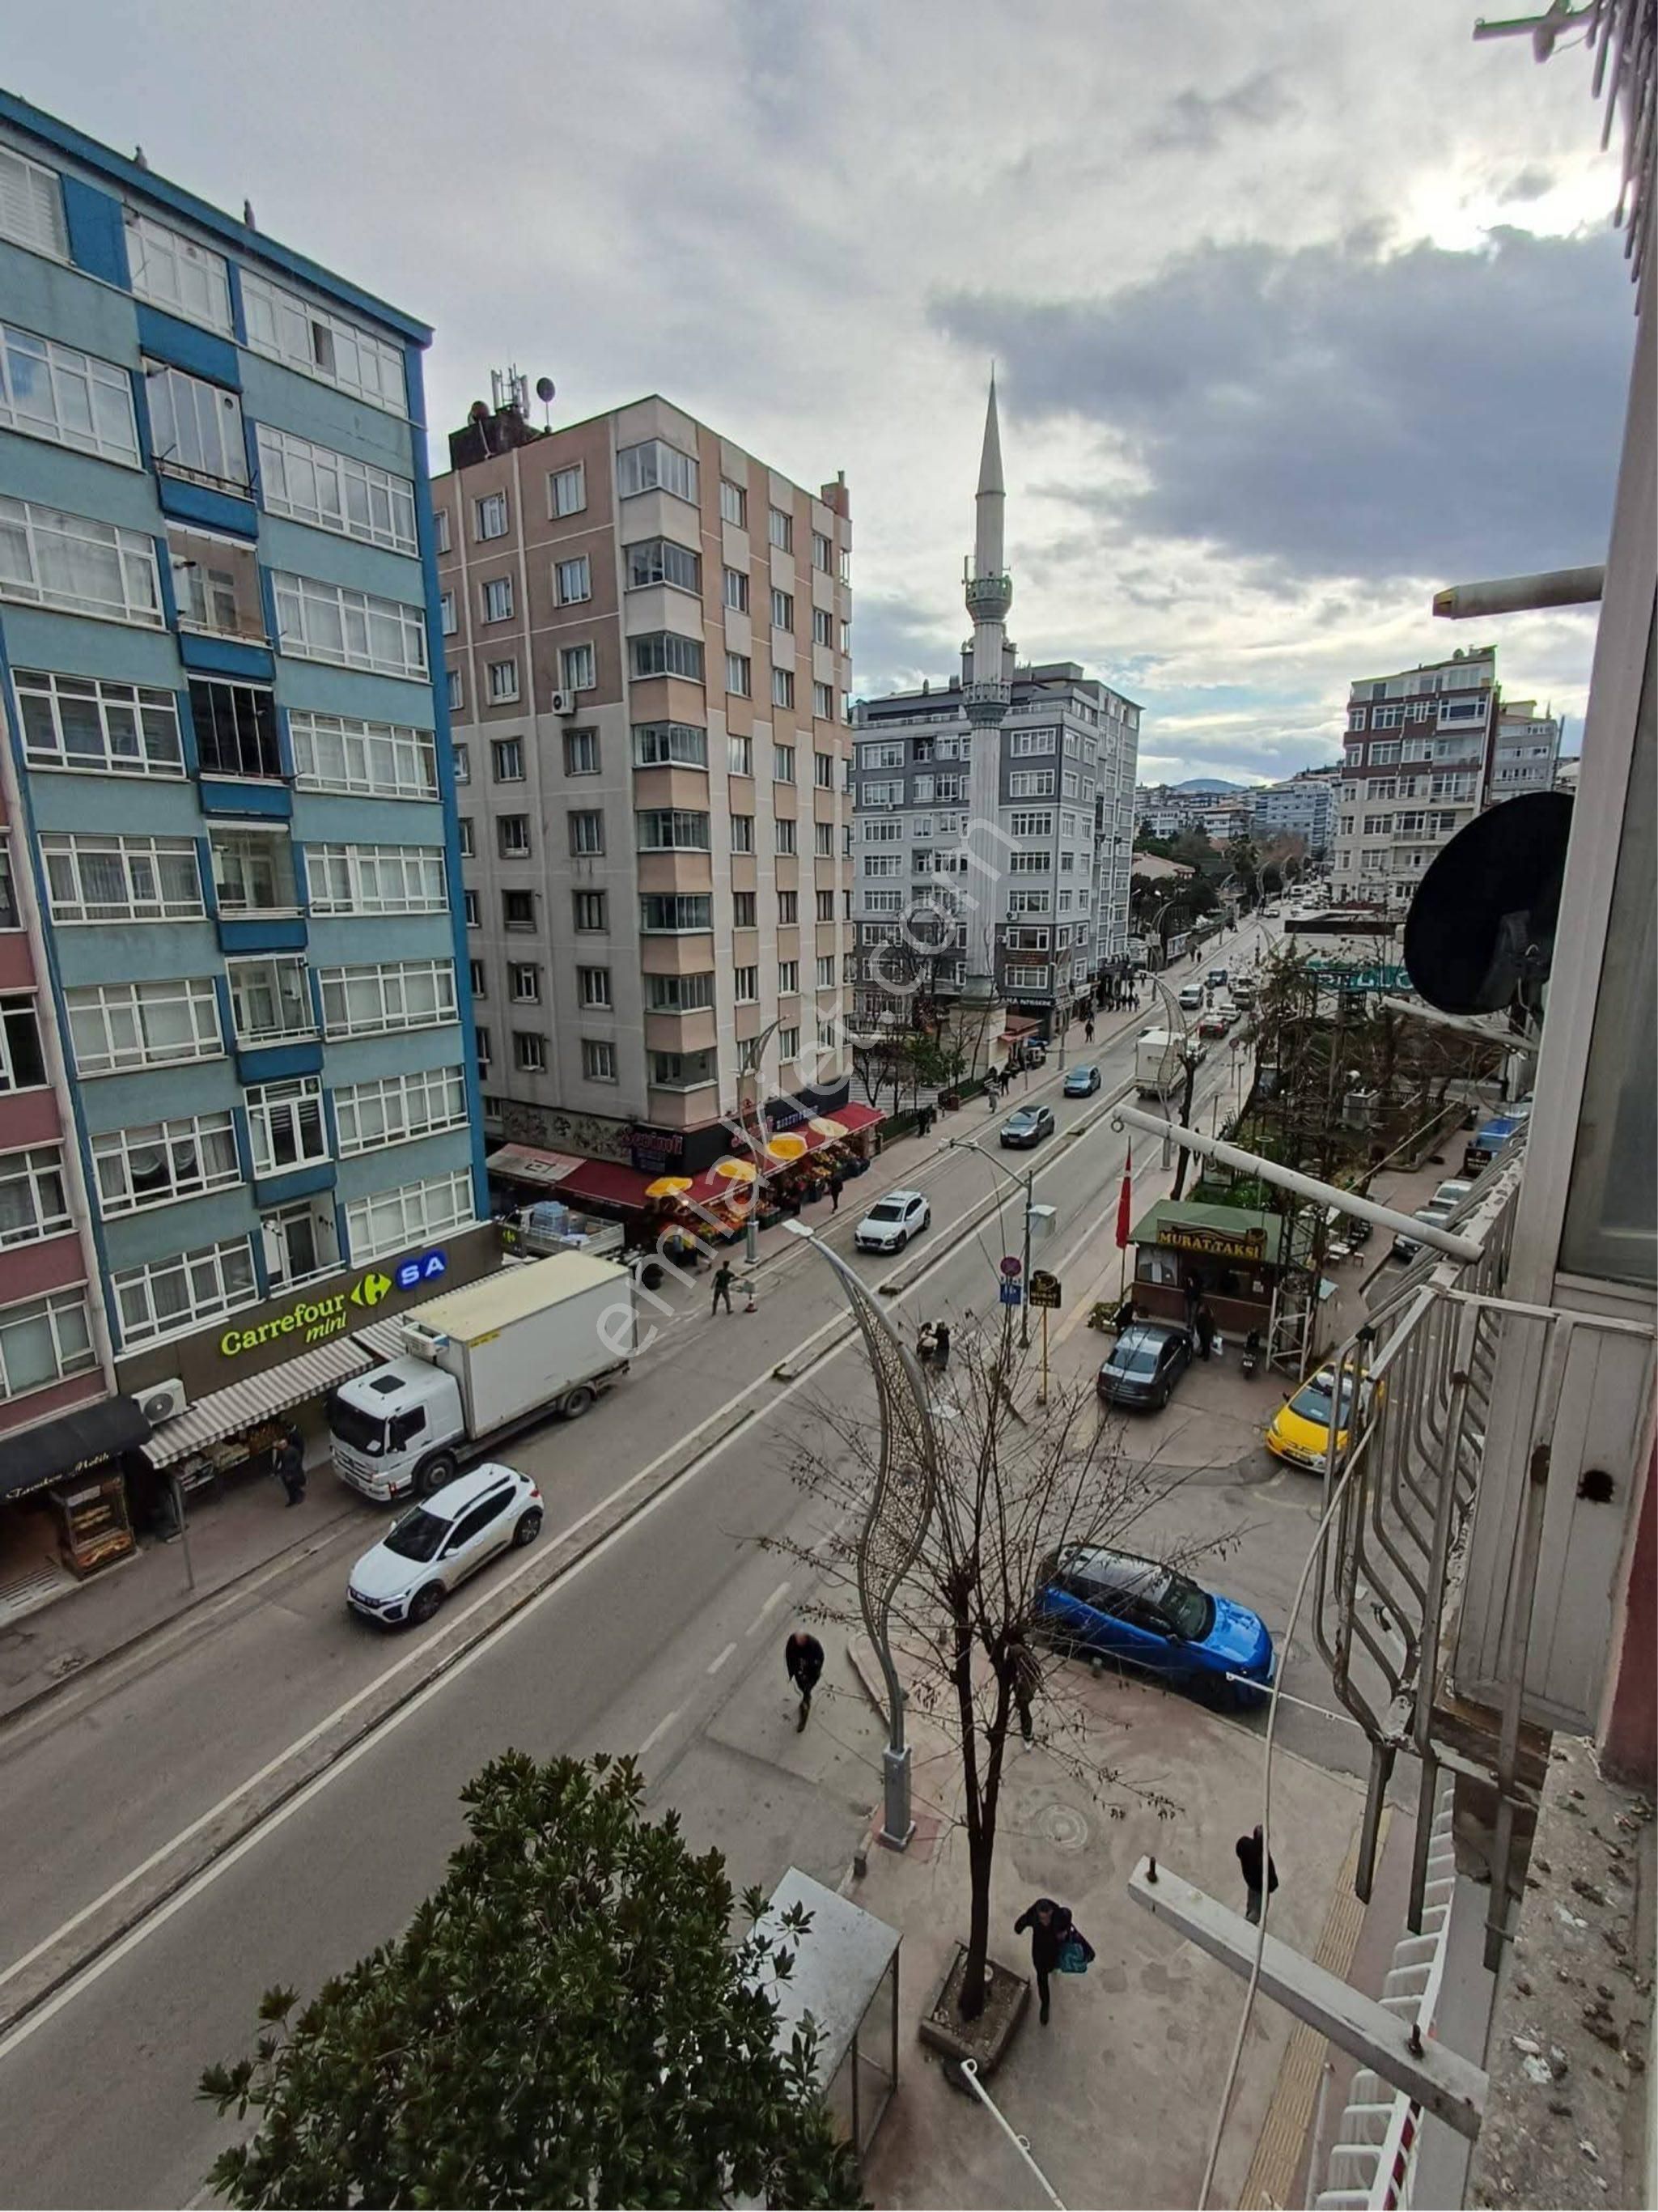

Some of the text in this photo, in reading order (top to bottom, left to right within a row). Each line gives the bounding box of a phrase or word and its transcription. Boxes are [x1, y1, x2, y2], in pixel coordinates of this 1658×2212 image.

[1159, 1231, 1211, 1250] MURAT
[221, 1294, 346, 1356] Carrefour
[305, 1312, 347, 1344] mini
